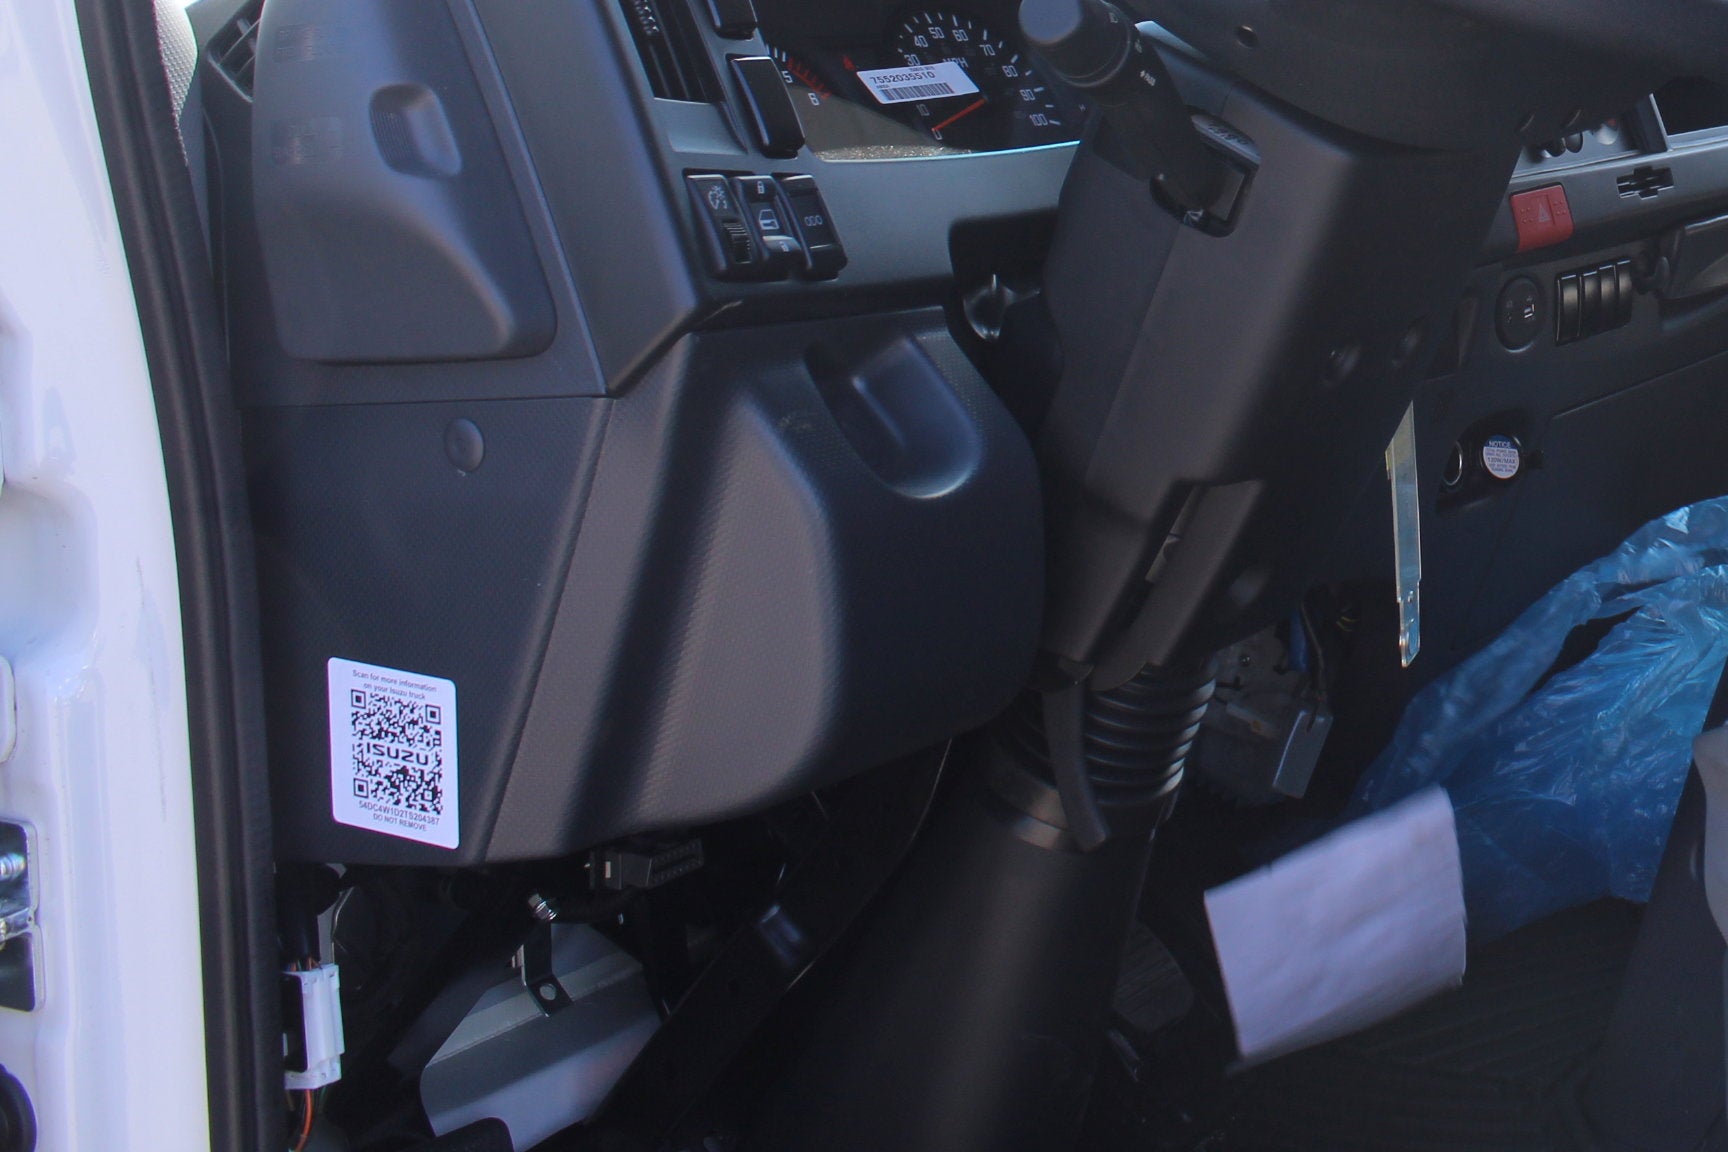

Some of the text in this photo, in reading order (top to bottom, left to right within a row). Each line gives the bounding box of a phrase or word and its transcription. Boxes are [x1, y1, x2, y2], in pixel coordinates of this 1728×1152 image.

[928, 26, 945, 39] 50
[952, 29, 969, 42] 60
[914, 35, 929, 48] 40
[979, 44, 996, 57] 70
[904, 54, 921, 66] 30
[781, 70, 794, 84] 5
[1002, 65, 1019, 78] 80
[808, 92, 820, 106] 6
[1019, 89, 1036, 101] 90
[916, 103, 930, 117] 10
[1029, 113, 1048, 127] 100
[933, 129, 942, 141] 0
[1488, 440, 1511, 448] NOTICE
[352, 669, 438, 692] Scan for more information
[374, 684, 388, 693] your
[408, 691, 426, 700] truck
[366, 741, 429, 766] ISUZU
[373, 813, 428, 832] DO NOT REMOVE
